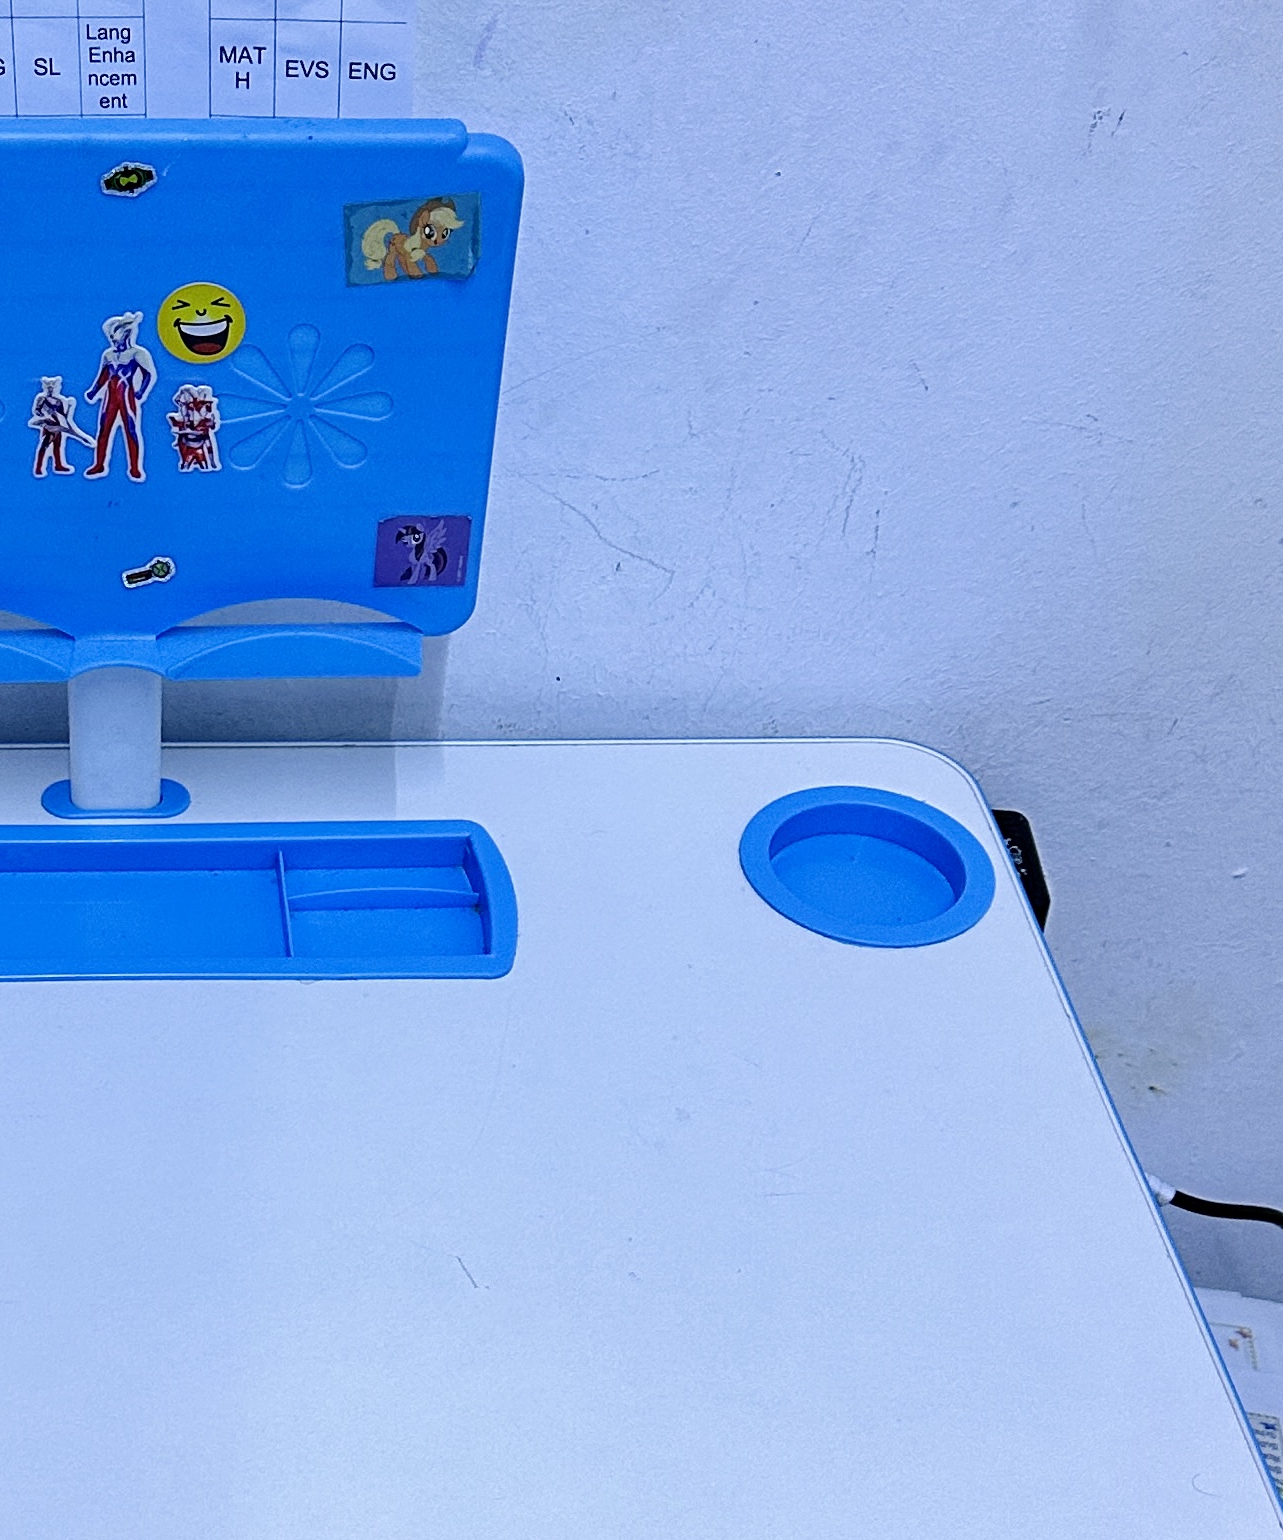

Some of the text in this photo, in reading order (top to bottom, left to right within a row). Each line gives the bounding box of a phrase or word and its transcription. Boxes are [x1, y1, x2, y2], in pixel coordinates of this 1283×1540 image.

[86, 24, 131, 43] Lang
[88, 47, 135, 63] Enha
[219, 46, 267, 64] MAT
[33, 57, 61, 76] SL
[285, 60, 329, 78] EVS
[348, 62, 396, 80] ENG
[88, 71, 137, 86] ncem
[235, 71, 250, 89] H
[99, 93, 128, 109] ent
